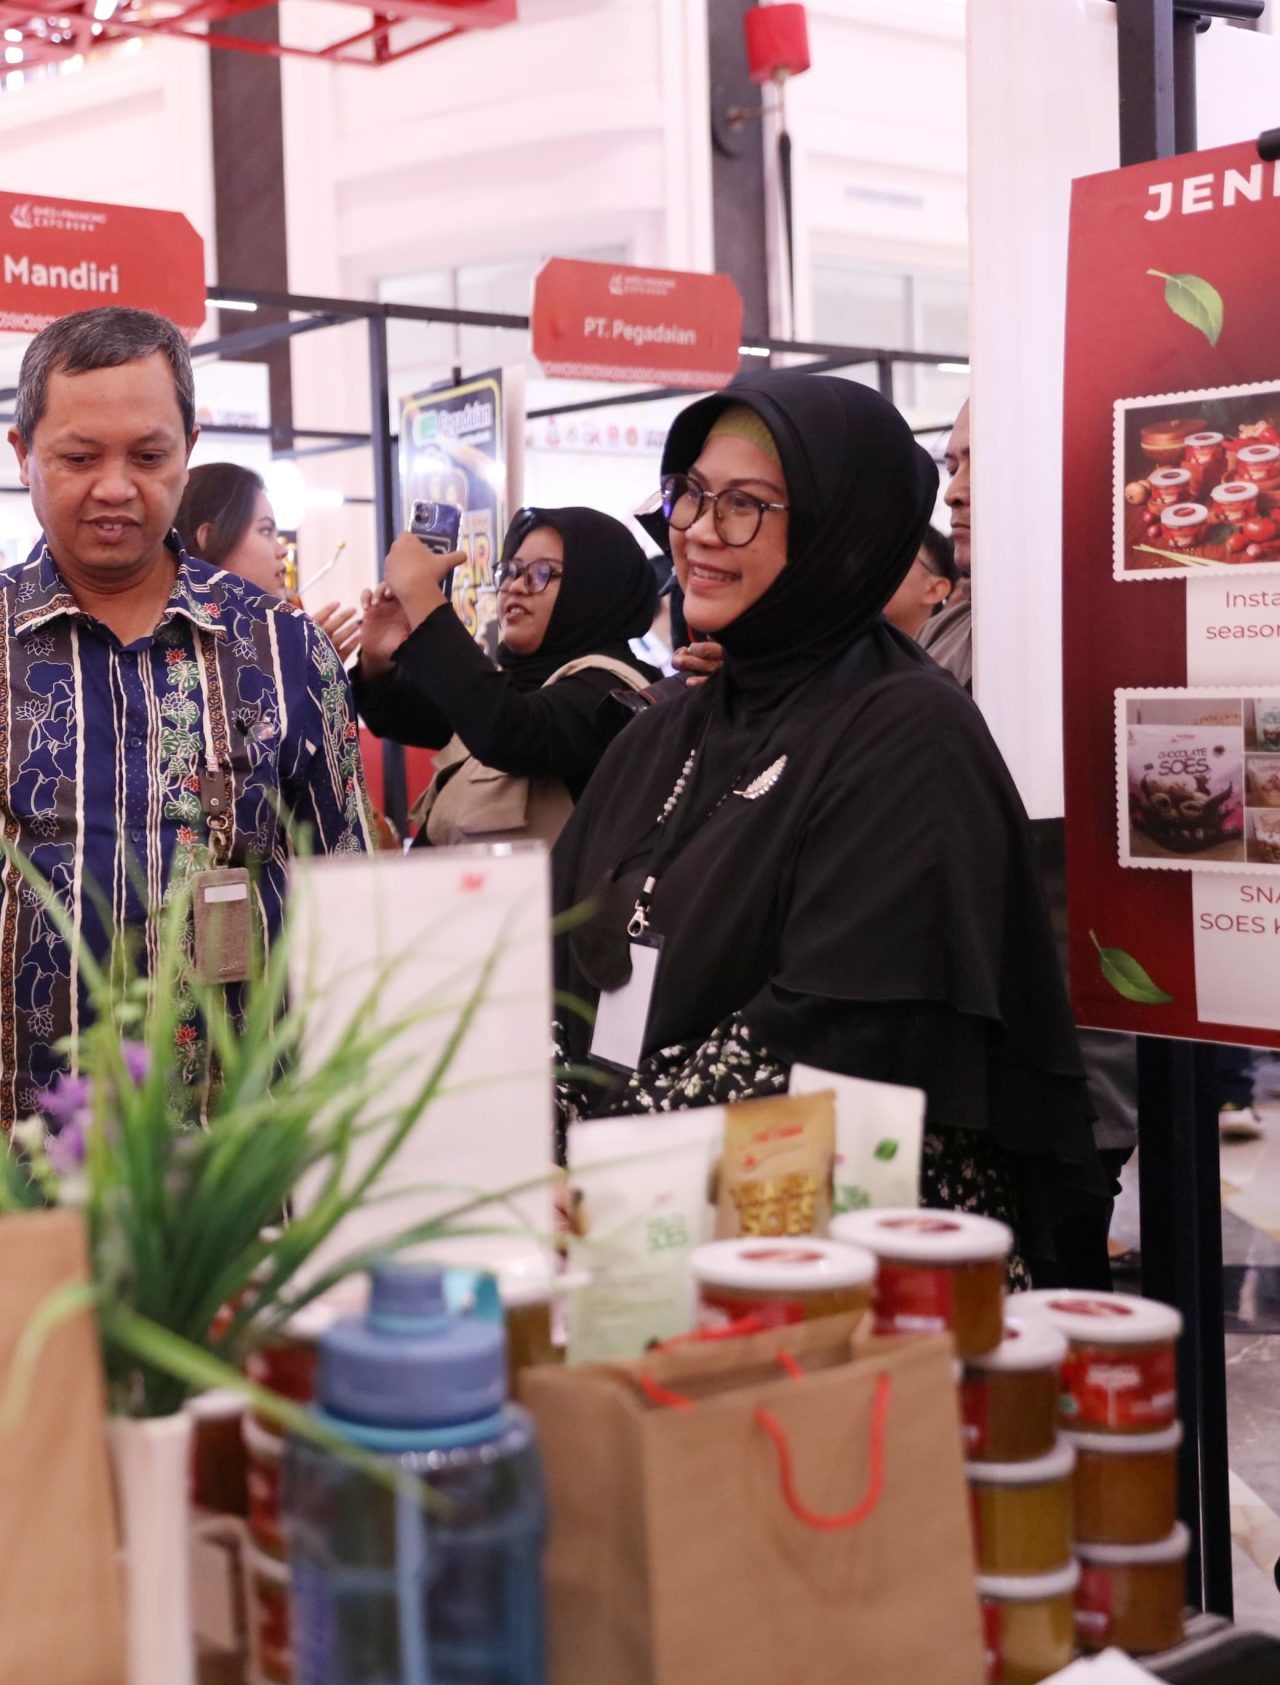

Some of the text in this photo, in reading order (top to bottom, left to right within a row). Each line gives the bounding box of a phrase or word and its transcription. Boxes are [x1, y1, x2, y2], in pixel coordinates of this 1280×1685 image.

[3, 253, 119, 294] Mandiri
[583, 316, 697, 347] PT. Pegadaian
[1157, 747, 1207, 759] CHOCOLATE
[1158, 758, 1210, 776] SOES
[1200, 912, 1265, 934] SOES
